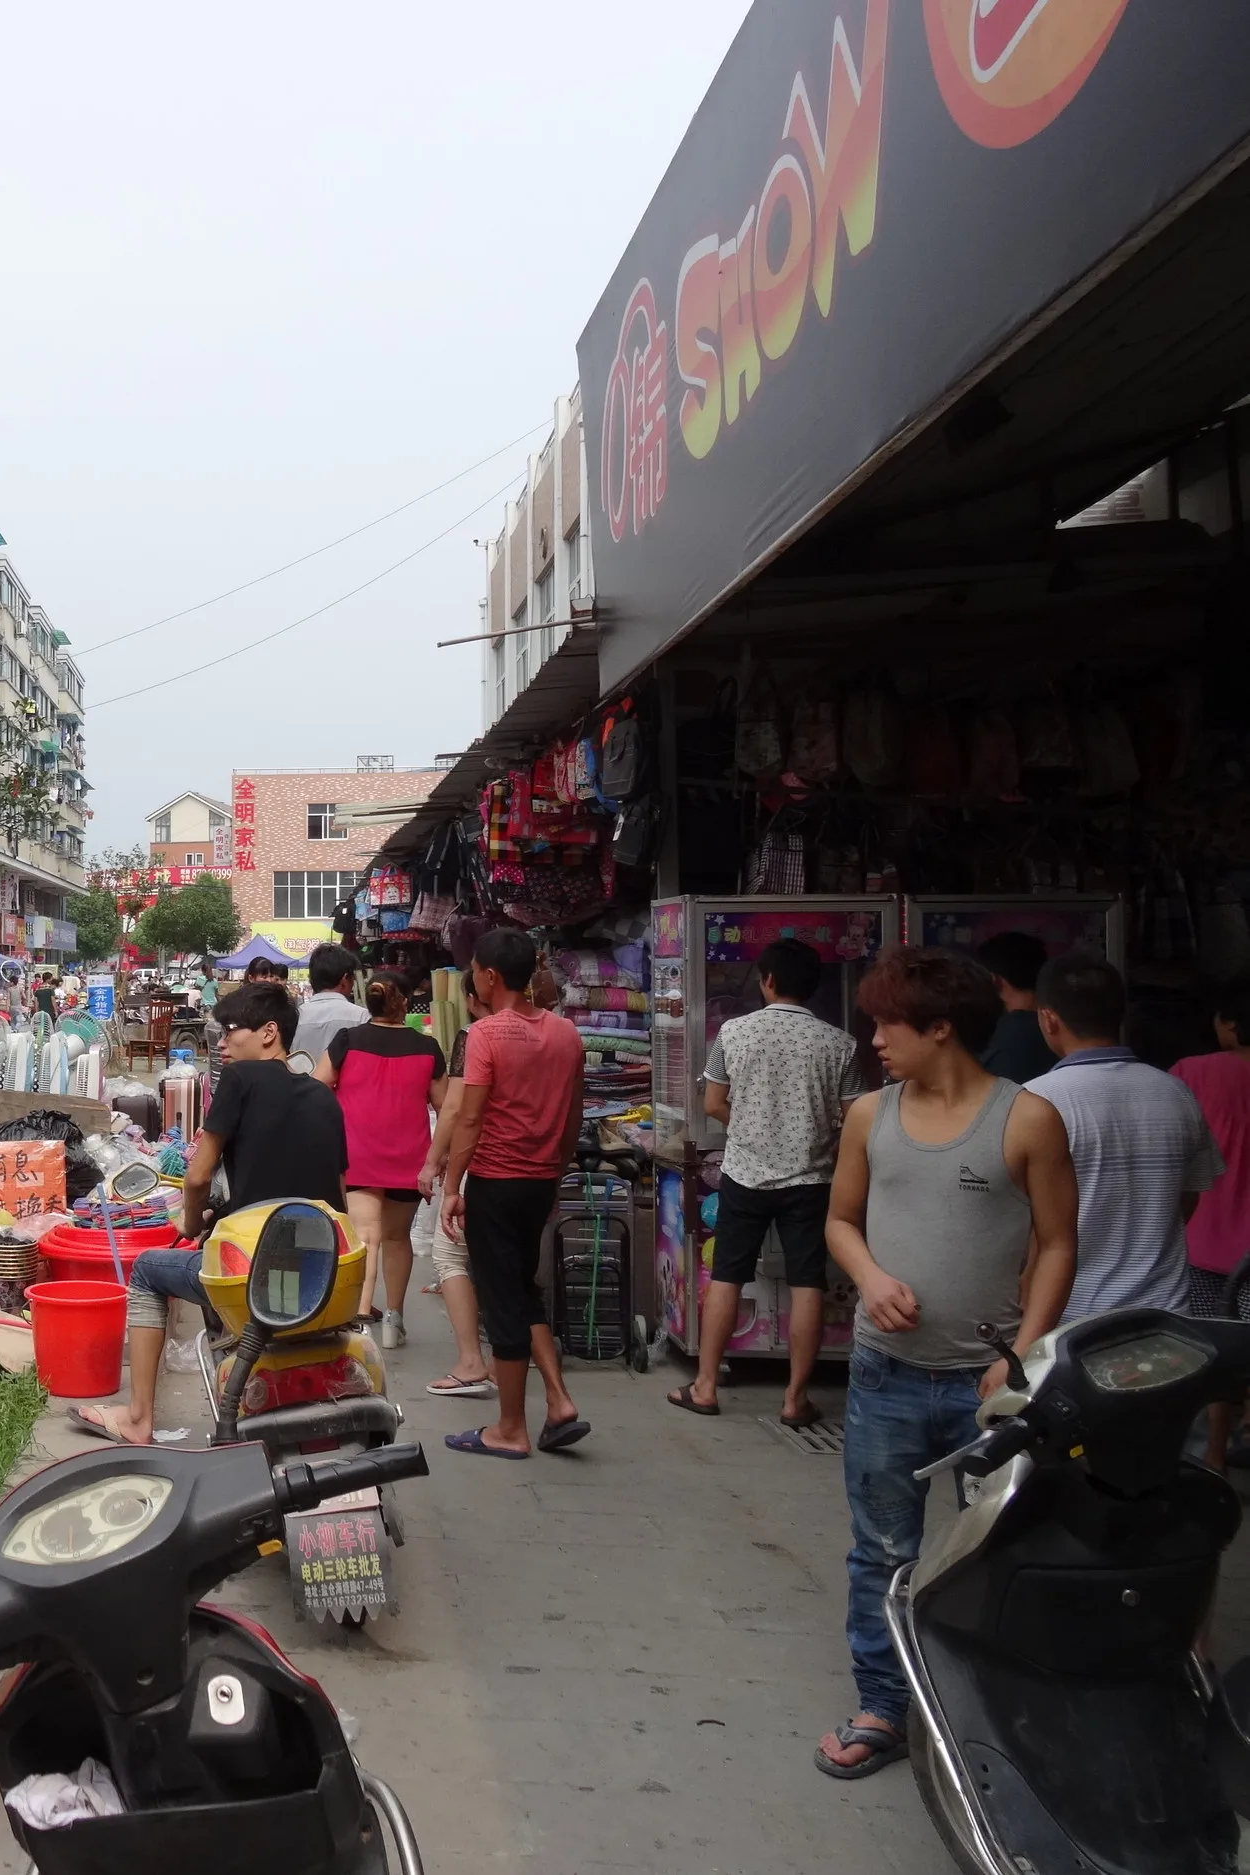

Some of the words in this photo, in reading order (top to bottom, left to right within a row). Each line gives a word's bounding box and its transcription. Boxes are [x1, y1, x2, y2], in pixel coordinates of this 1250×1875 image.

[234, 778, 256, 872] 全明家私
[959, 1184, 990, 1193] TORNADO
[299, 1518, 377, 1559] 小柳车行
[301, 1553, 383, 1583] 电动三轮车批发
